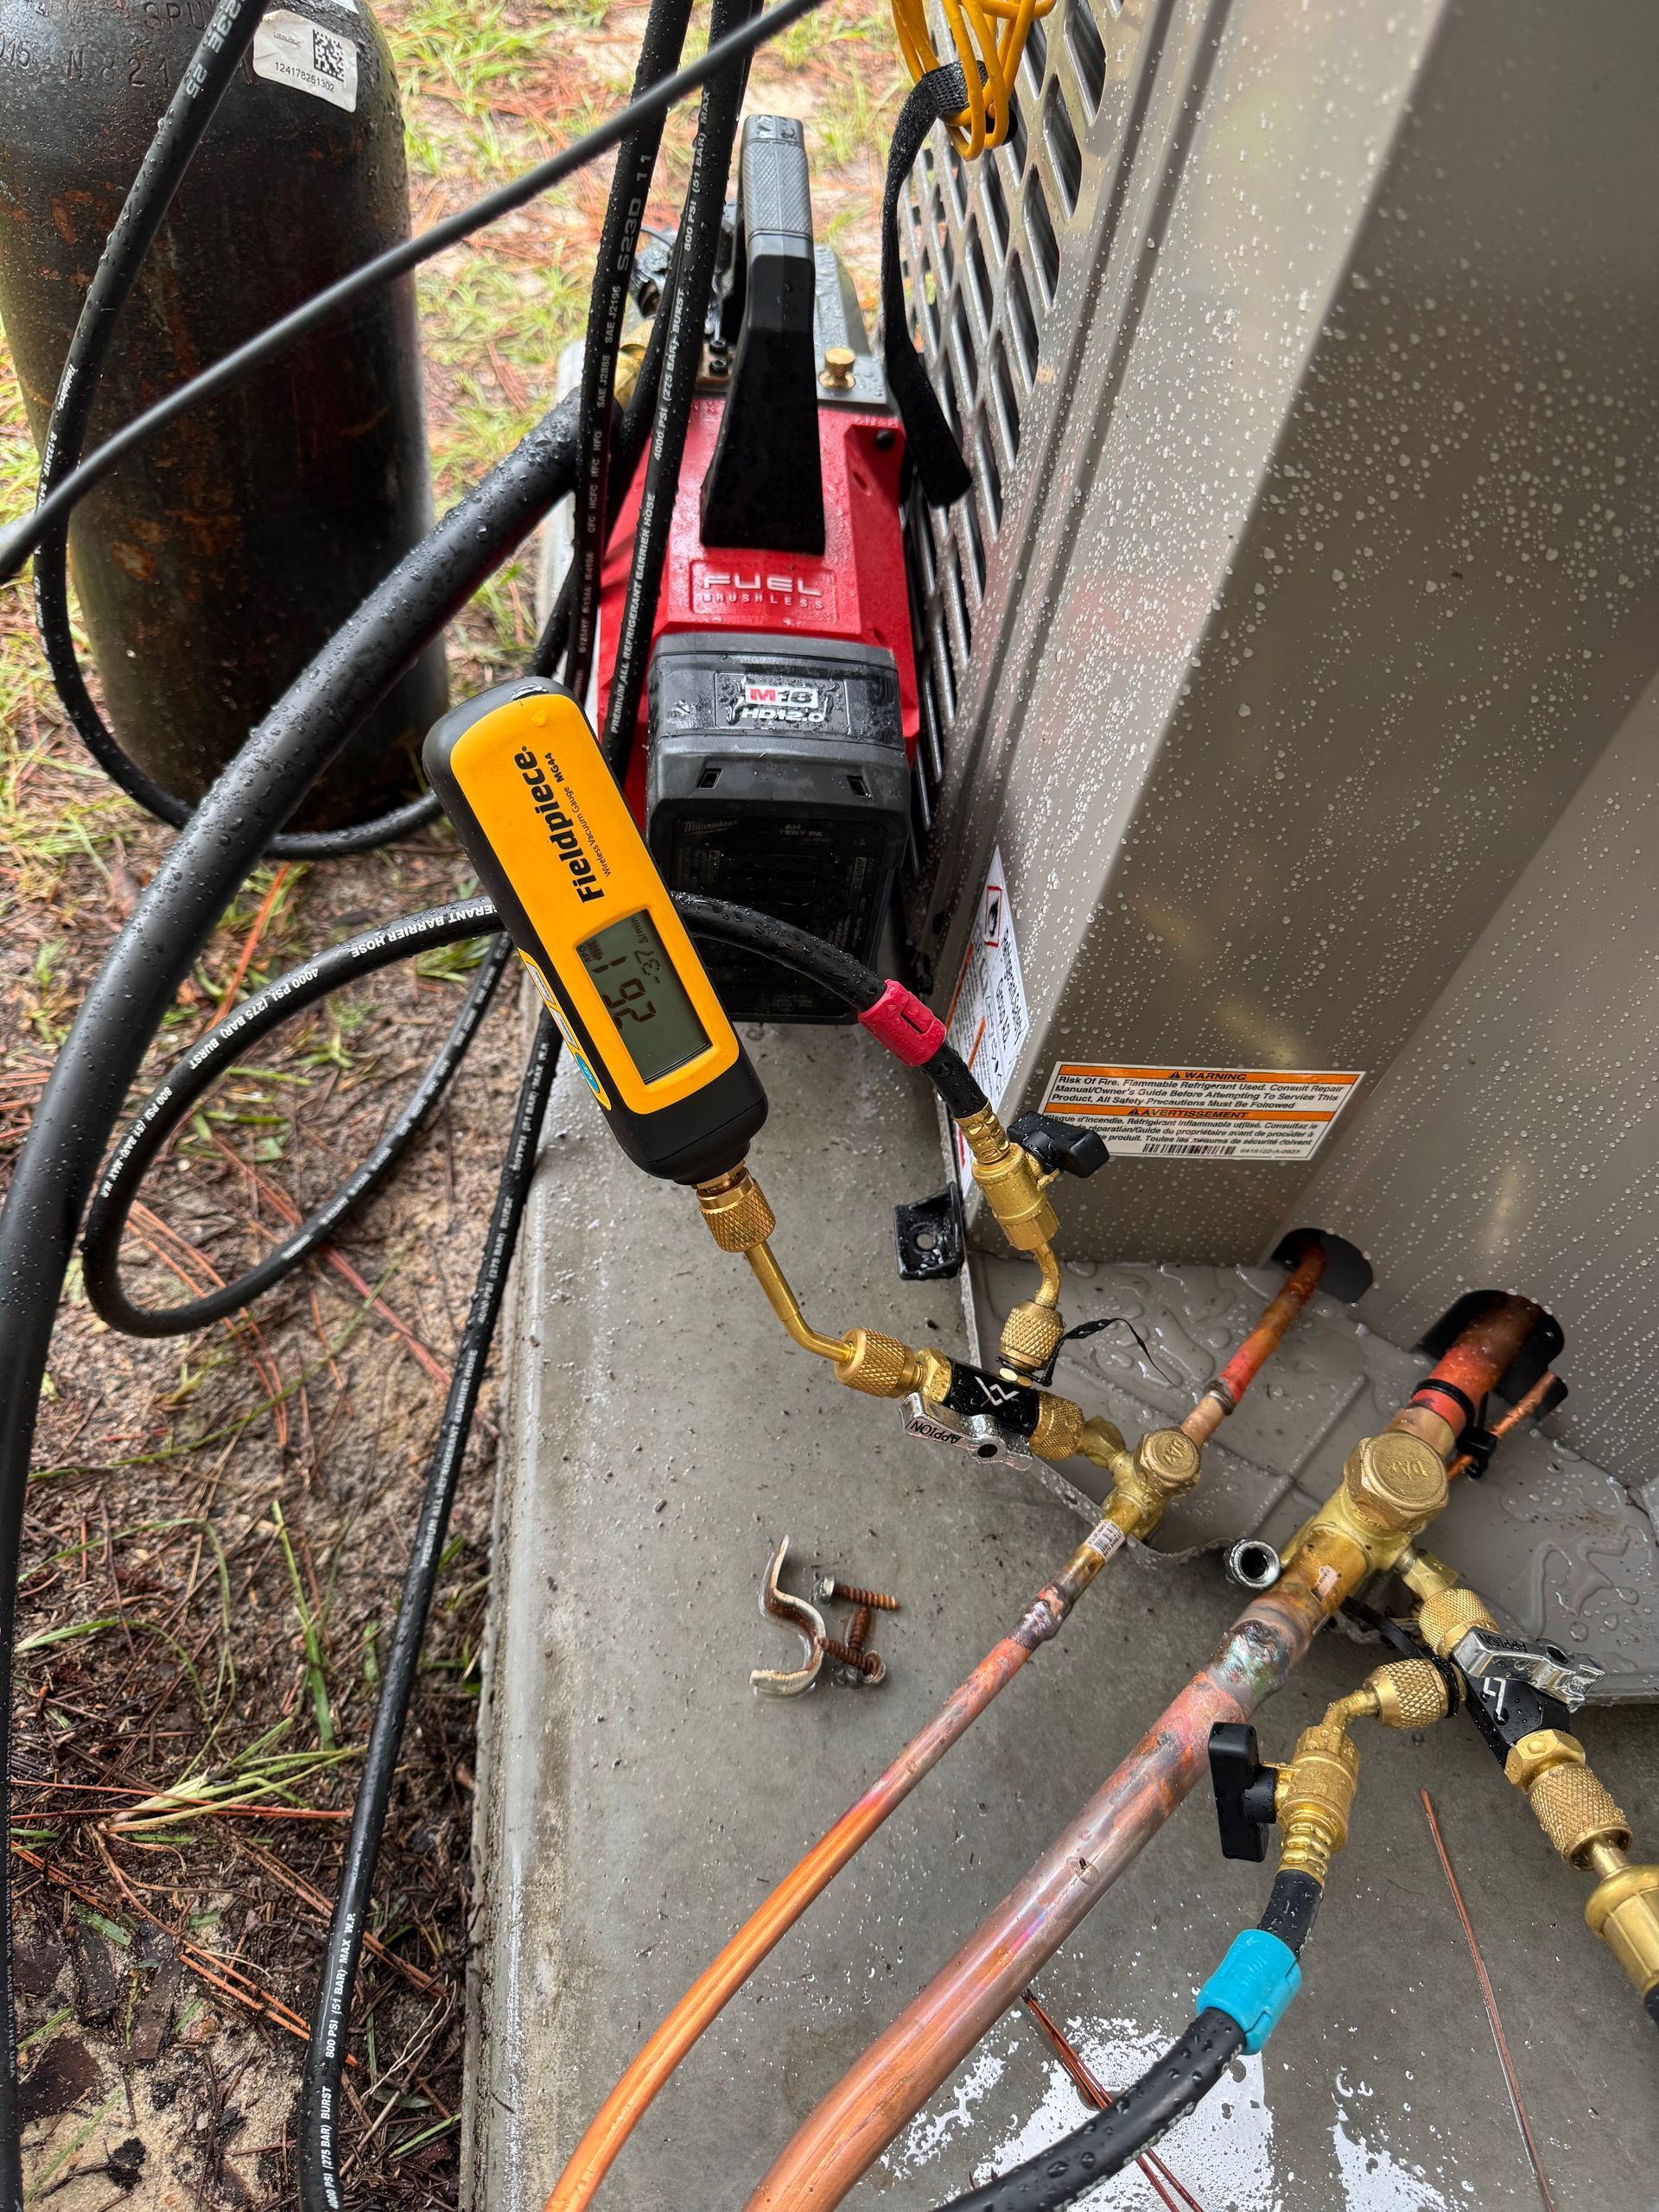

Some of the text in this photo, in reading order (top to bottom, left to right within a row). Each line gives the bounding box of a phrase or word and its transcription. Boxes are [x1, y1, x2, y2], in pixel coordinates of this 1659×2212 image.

[187, 63, 207, 99] 25
[274, 61, 335, 93] 124178251302
[701, 91, 709, 124] MAX
[696, 132, 706, 168] BAR)
[692, 170, 701, 194] (51
[688, 200, 697, 224] PSI
[684, 226, 694, 251] 800
[605, 323, 613, 345] SAE
[618, 197, 641, 271] S23D
[675, 288, 685, 335] BURST
[659, 408, 668, 428] PSI
[654, 431, 664, 461] 4000
[644, 493, 655, 526] HOSE
[636, 528, 650, 580] BARRIER
[703, 572, 822, 596] FUEL
[702, 593, 823, 610] BRUSHLESS
[626, 582, 642, 661] REFRIGERANT
[611, 683, 624, 734] PREMIUM
[514, 748, 605, 904] Fieldpiece
[544, 753, 611, 877] Wireless Vacuum Gauge MG44
[389, 915, 444, 943] BARRIER
[351, 933, 386, 959] HOSE
[579, 945, 593, 963] APO
[292, 968, 319, 988] 4000
[272, 988, 292, 1002] PSI
[593, 955, 657, 1031] 261
[246, 998, 269, 1020] (275
[220, 1017, 247, 1039] BAR)
[188, 1038, 220, 1071] BURST
[1058, 1077, 1081, 1085] Risk
[1099, 1077, 1119, 1086] Fire.
[1122, 1079, 1178, 1088] Flammable
[1179, 1082, 1236, 1090] Refrigerant
[1185, 1071, 1246, 1080] WARNING
[156, 1086, 173, 1106] 800
[1052, 1094, 1093, 1103] Product.
[1112, 1096, 1143, 1105] Safety
[1055, 1085, 1135, 1096] Manual/Owner's
[1138, 1088, 1167, 1096] Guide
[1205, 1091, 1260, 1101] Attempting
[144, 1103, 160, 1122] PSI
[1077, 1116, 1124, 1124] d'incendie.
[1127, 1118, 1177, 1127] Réfrigérant
[1178, 1119, 1231, 1128] inflammable
[1141, 1109, 1249, 1118] AVERTISSEMENT
[1089, 1125, 1160, 1135] réparation/Guide
[910, 1421, 963, 1444] APPION
[420, 1516, 439, 1568] PREMIUM
[345, 1912, 356, 1934] W.P.
[340, 1939, 352, 1965] MAX
[334, 1968, 347, 1998] BAR)
[331, 1995, 342, 2016] (51
[327, 2018, 339, 2038] PSI
[325, 2037, 336, 2059] 800
[321, 2086, 333, 2122] BURST
[321, 2124, 333, 2152] BAR)
[322, 2150, 333, 2171] (275
[323, 2173, 334, 2190] PSI
